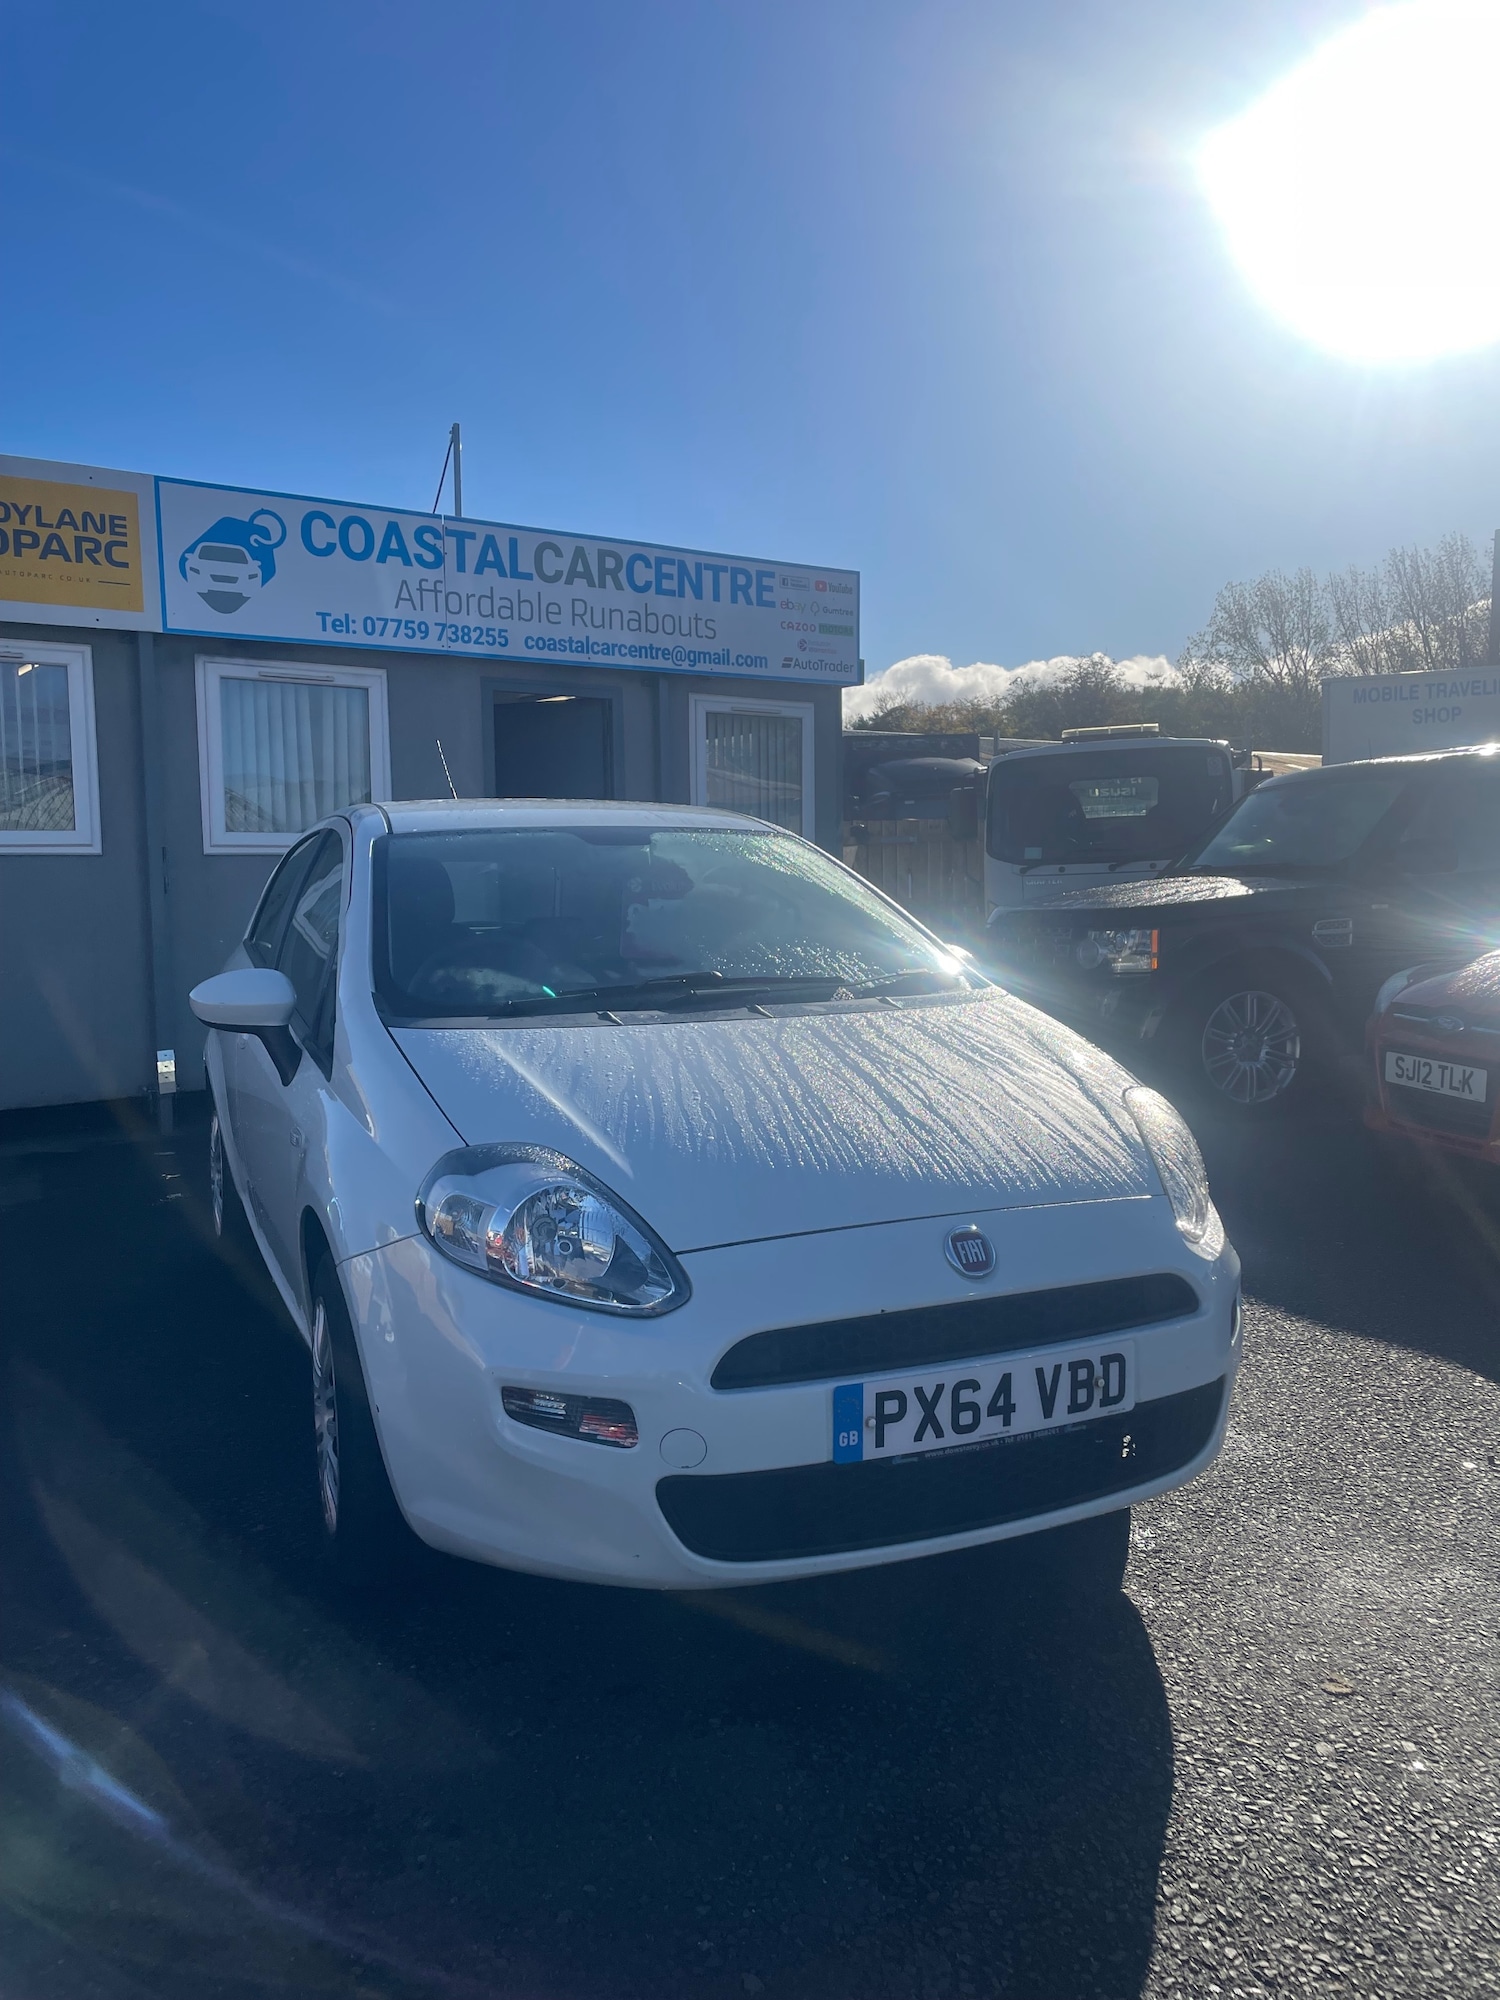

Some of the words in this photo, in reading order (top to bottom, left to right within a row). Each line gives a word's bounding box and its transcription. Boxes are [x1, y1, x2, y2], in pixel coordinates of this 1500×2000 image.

[300, 509, 777, 609] COASTALCARCENTRE
[828, 582, 853, 595] YouTube
[394, 578, 562, 625] Affordable
[571, 598, 717, 640] Runabouts
[780, 598, 806, 614] ebay
[822, 606, 854, 616] Gumtree
[315, 611, 357, 635] Tel:
[362, 616, 430, 640] 07759
[434, 622, 509, 648] 738255
[524, 635, 768, 669] coastalcarcentre@gmail.com
[793, 658, 854, 673] AutoTrader
[1353, 684, 1420, 704] MOBILE
[1424, 679, 1500, 699] TRAVELI
[1412, 706, 1462, 725] SHOP
[1394, 1055, 1433, 1087] SJ12
[1438, 1064, 1475, 1095] TLK
[955, 1238, 986, 1264] FIAT
[874, 1371, 1016, 1449] PX64
[1035, 1352, 1127, 1420] VBD
[839, 1429, 859, 1447] GB
